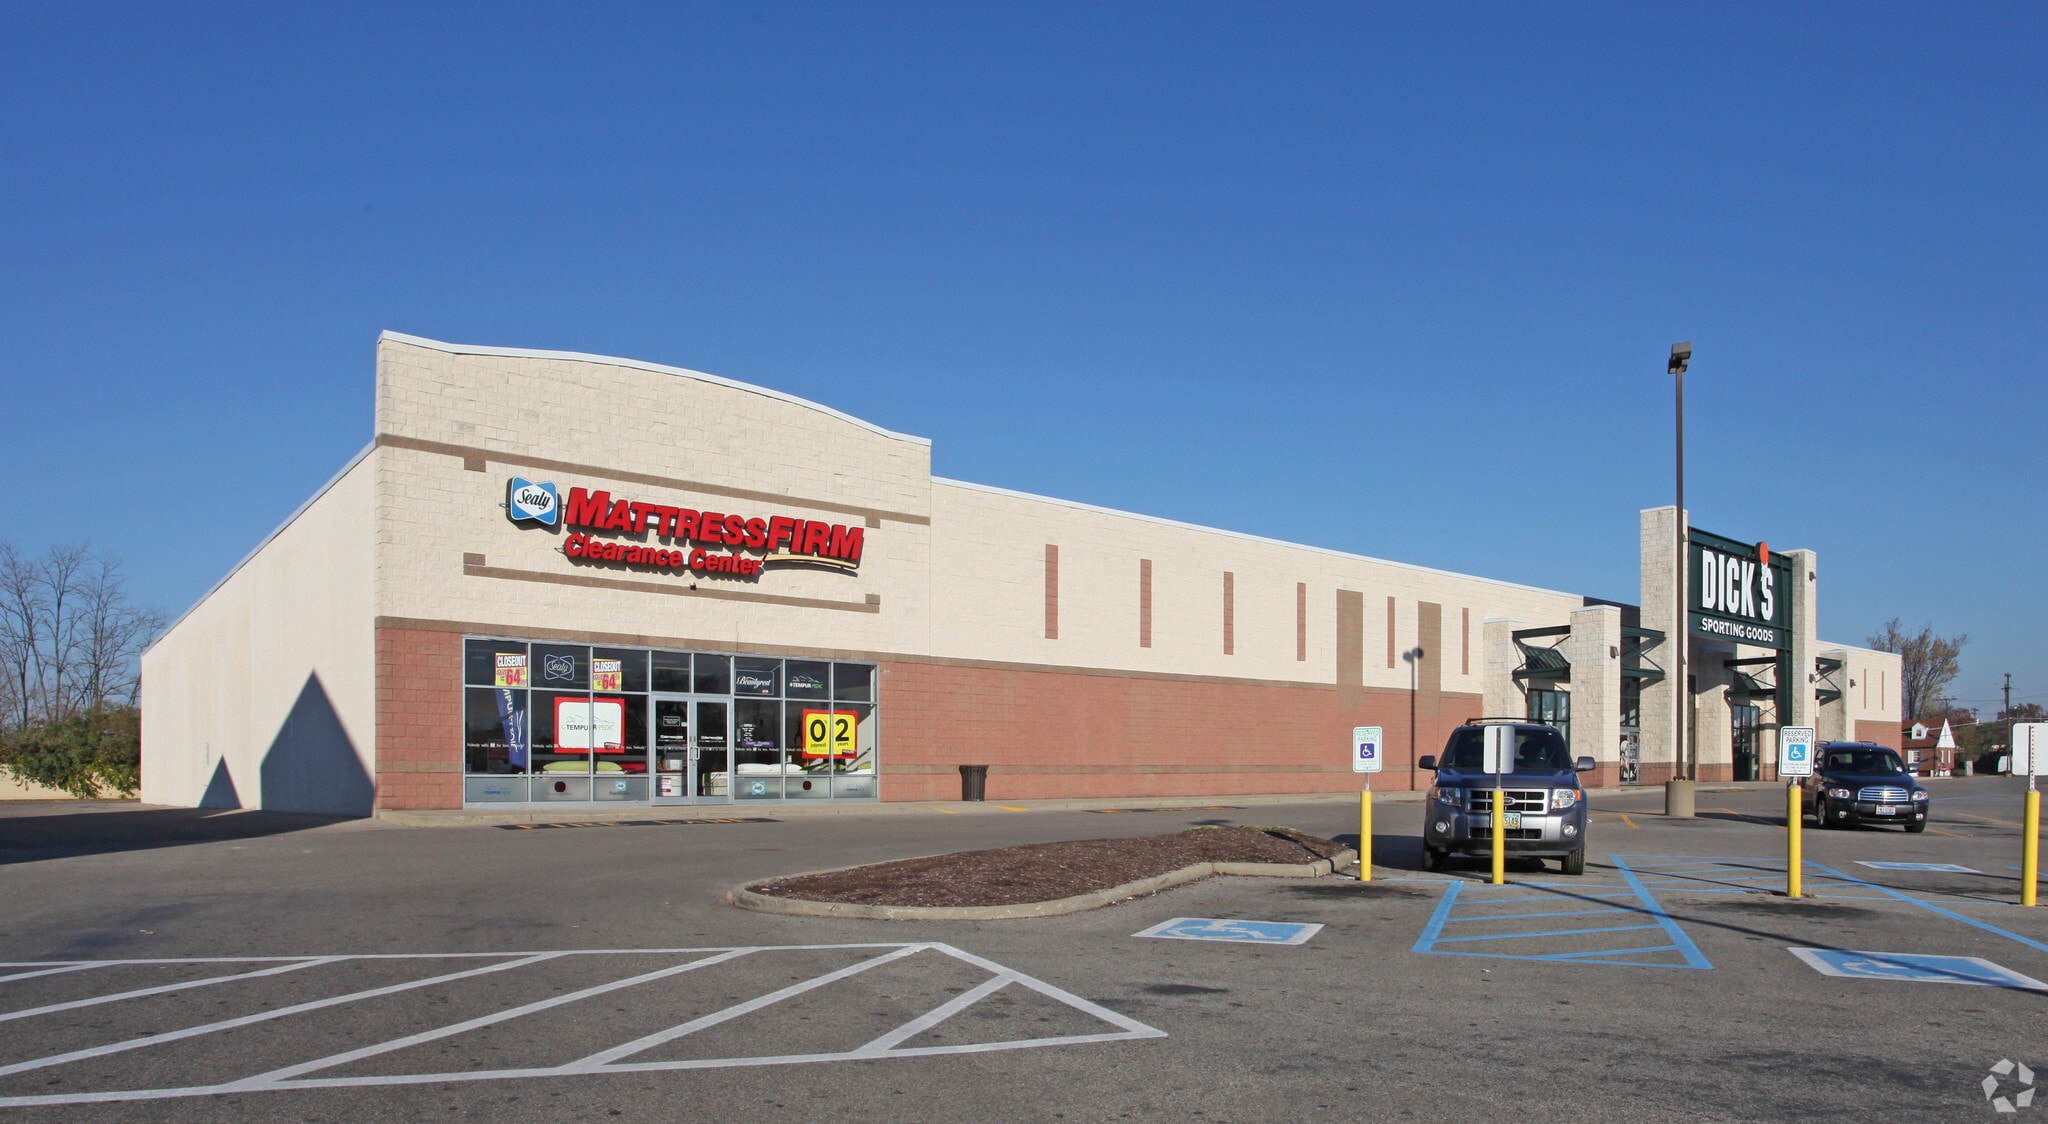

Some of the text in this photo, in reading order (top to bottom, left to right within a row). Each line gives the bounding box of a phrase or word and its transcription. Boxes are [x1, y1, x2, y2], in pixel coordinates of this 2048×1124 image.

[517, 488, 551, 510] Sealy
[563, 532, 763, 576] Clearance Center
[1702, 549, 1774, 621] DICK'S
[1701, 617, 1774, 642] SPORTING GOODS
[497, 655, 527, 668] CLOSEOUT
[549, 661, 569, 673] Sealy
[594, 660, 621, 673] CLOSEOUT
[505, 668, 521, 685] 64
[602, 673, 617, 689] 64
[810, 719, 826, 742] 0
[835, 718, 849, 741] 2
